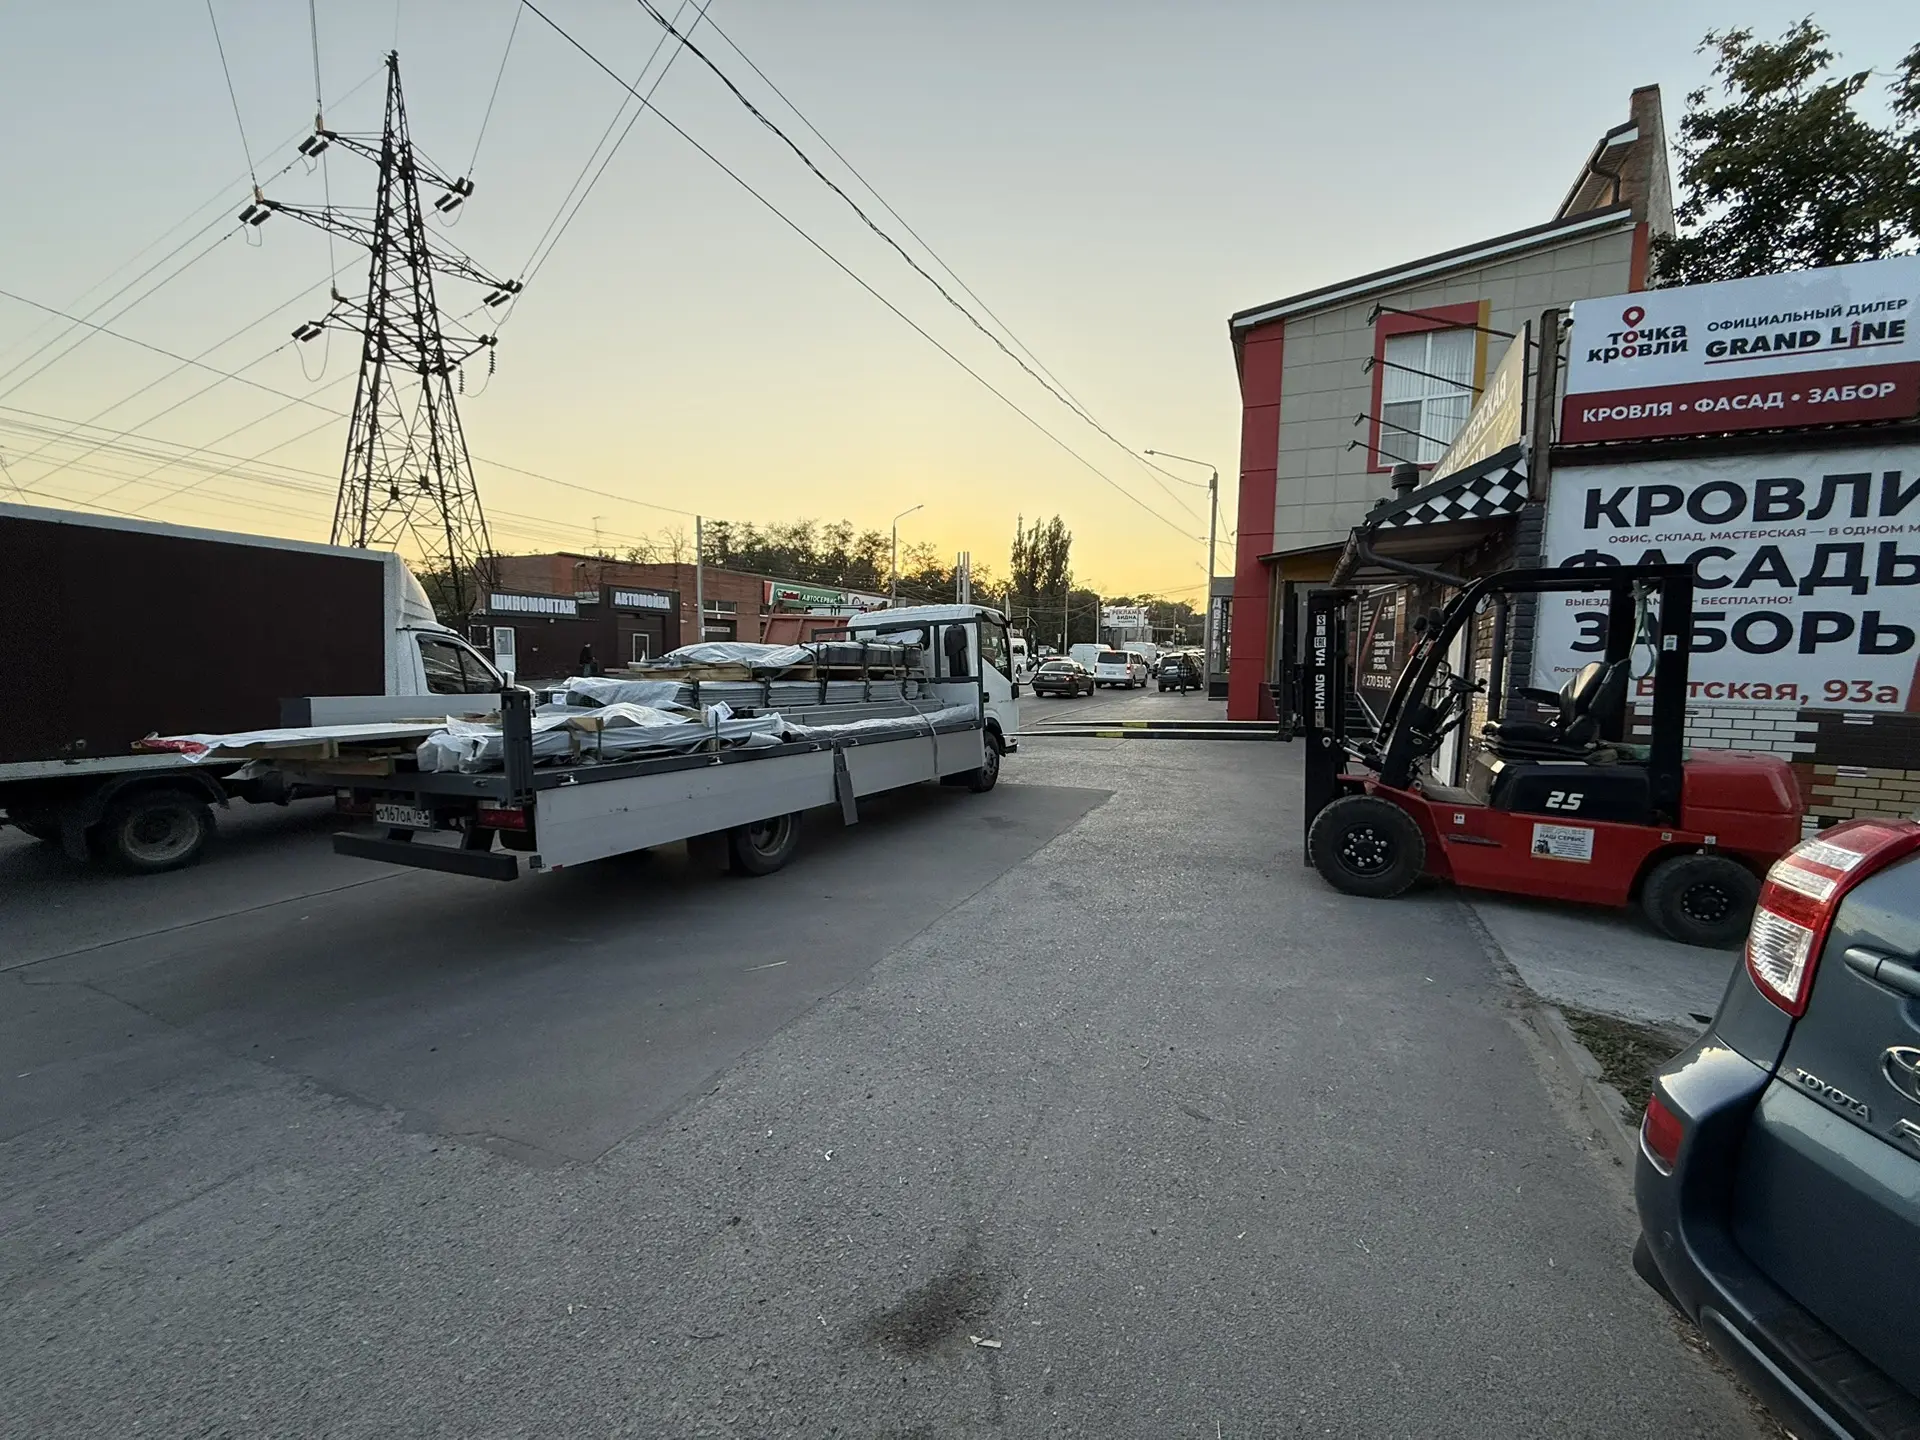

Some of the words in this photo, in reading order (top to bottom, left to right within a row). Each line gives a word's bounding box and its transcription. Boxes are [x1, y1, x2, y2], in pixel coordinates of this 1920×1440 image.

[1707, 304, 1842, 332] ОФИЦИАЛЬНЫЙ
[1846, 299, 1908, 317] ДИЛЕР
[1705, 329, 1821, 357] GRAND
[1583, 402, 1673, 422] КРОВЛЯ
[1694, 392, 1785, 413] ФАСАД
[1807, 382, 1896, 404] ЗАБОР
[1608, 534, 1651, 544] ОФИС,
[1655, 532, 1706, 542] СКЛАД,
[1710, 528, 1806, 541] МАСТЕРСКАЯ
[1829, 528, 1838, 536] В
[1843, 525, 1903, 536] ОДНОМ
[490, 594, 576, 614] ШИНОМОНТАЖ
[614, 591, 670, 609] АВТОМОЙКА
[1701, 596, 1793, 605] БЕСПЛАТНО!
[1635, 677, 1809, 705] Втская,
[1823, 680, 1899, 704] 93а
[1545, 791, 1584, 810] 25
[1797, 1068, 1869, 1121] TOYOTA
